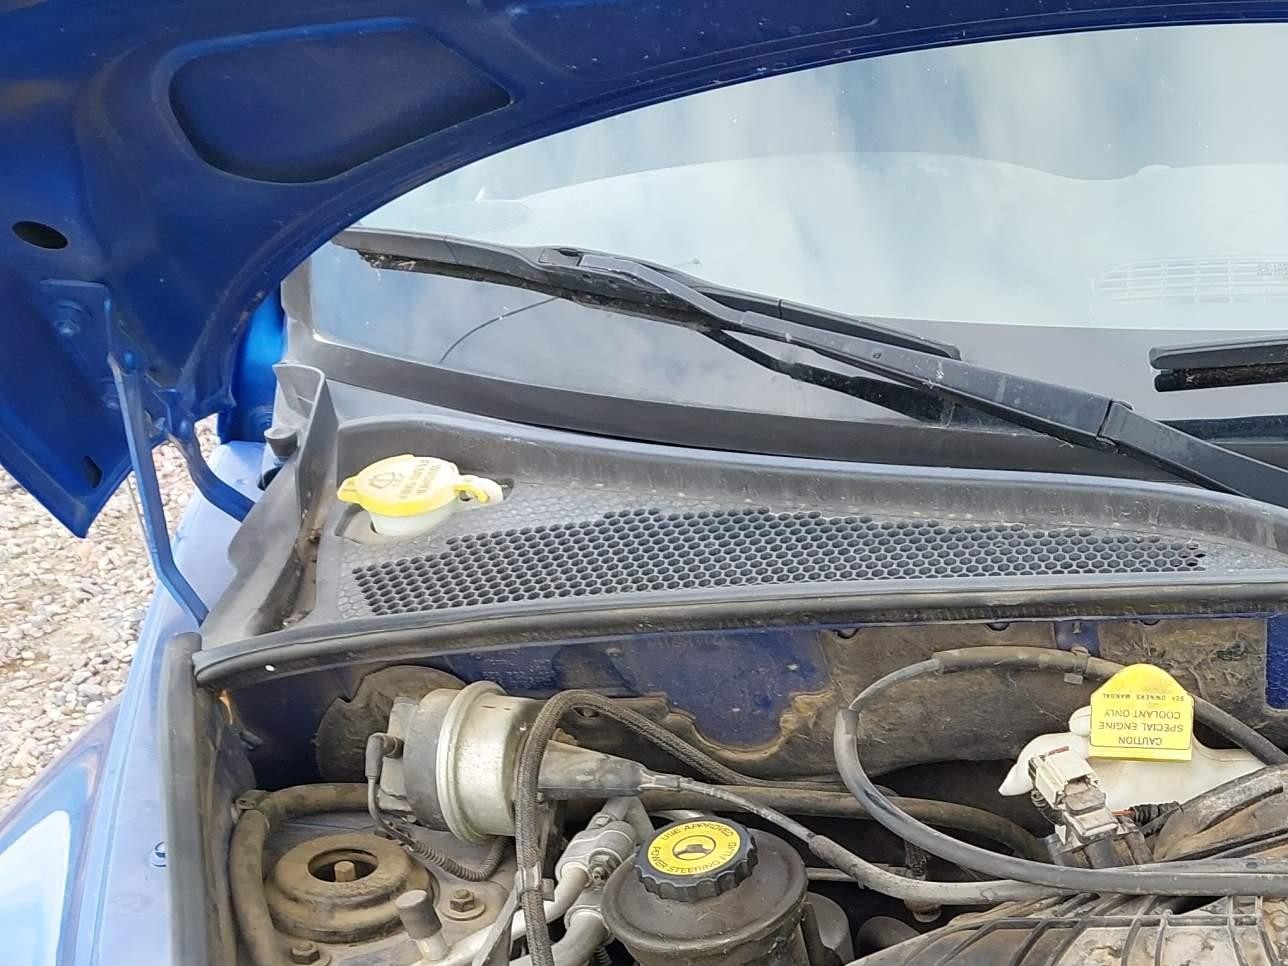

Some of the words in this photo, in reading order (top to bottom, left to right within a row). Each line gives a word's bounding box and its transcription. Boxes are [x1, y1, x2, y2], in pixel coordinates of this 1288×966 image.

[1104, 709, 1131, 718] ONLY
[1132, 709, 1181, 719] COOLANT
[1098, 721, 1138, 731] ENGINE
[1142, 722, 1184, 732] SPECIAL
[1118, 736, 1162, 746] CAUTION
[684, 822, 734, 838] APPROVED
[652, 846, 668, 873] POWER
[667, 860, 721, 874] STEERING
